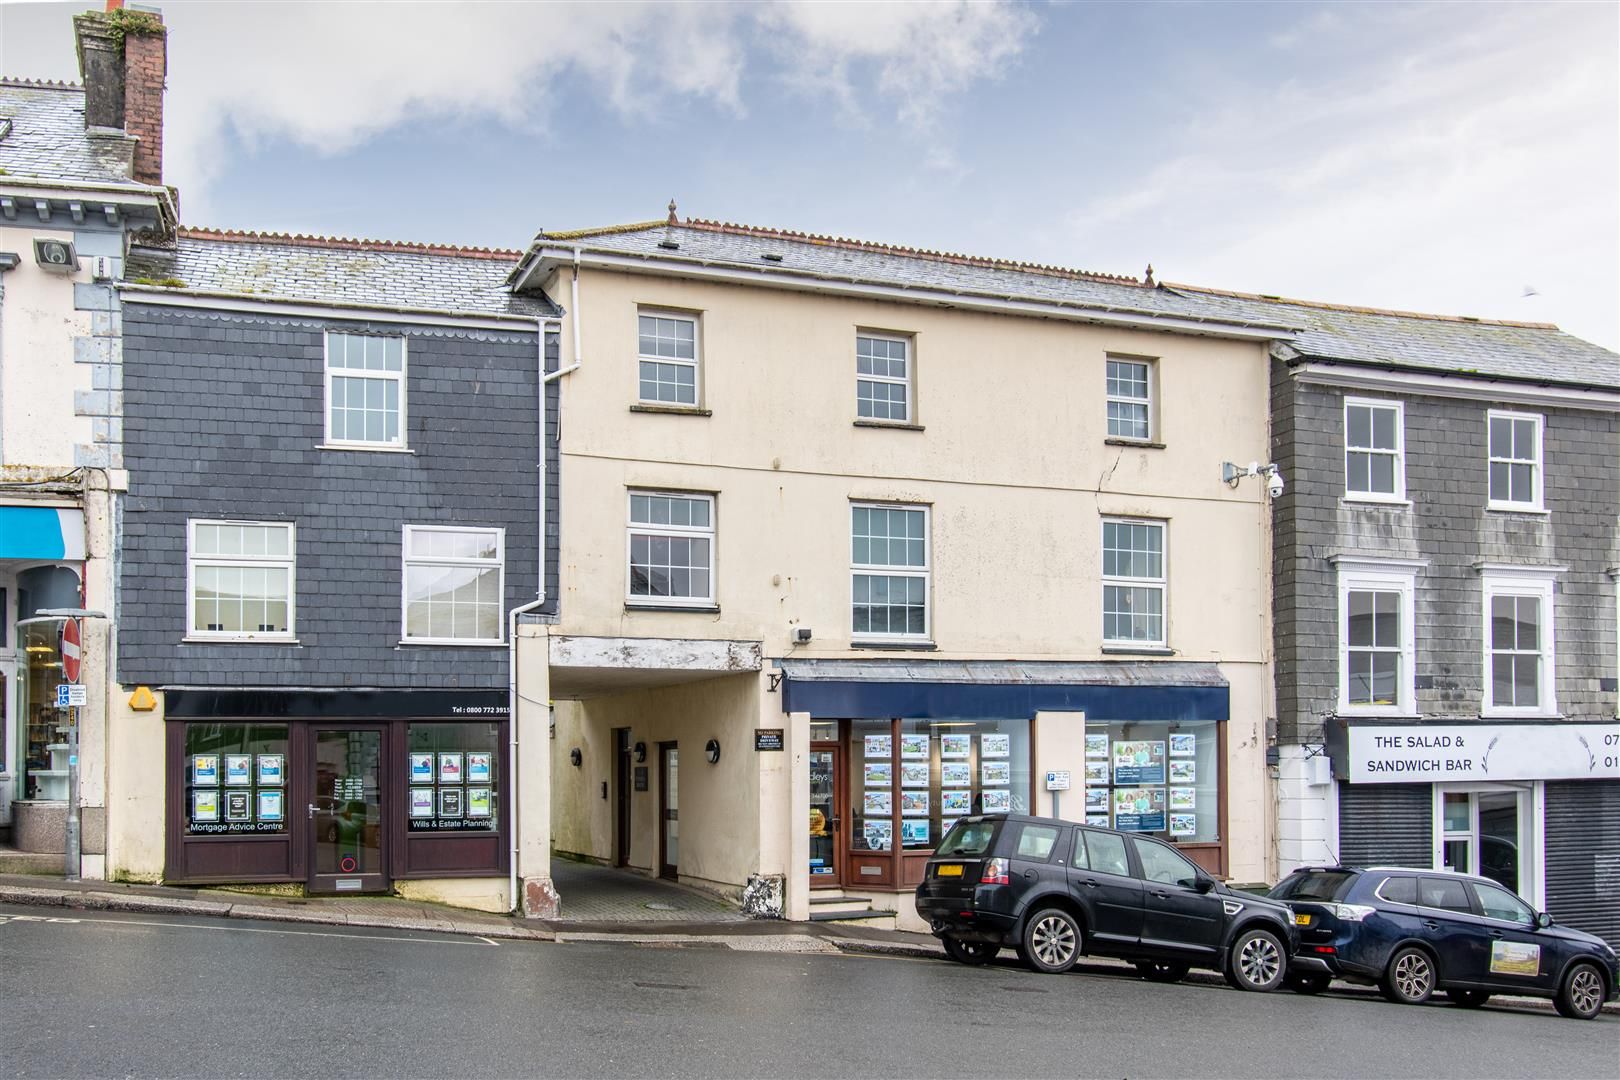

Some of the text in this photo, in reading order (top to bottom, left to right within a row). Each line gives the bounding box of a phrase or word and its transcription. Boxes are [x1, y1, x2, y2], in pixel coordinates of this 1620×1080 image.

[1374, 736, 1465, 748] THE SALAD &
[1367, 759, 1472, 772] SANDWICH BAR
[190, 822, 283, 832] Mortgage Advice Centre
[412, 819, 494, 829] Wills & Estate Planning
